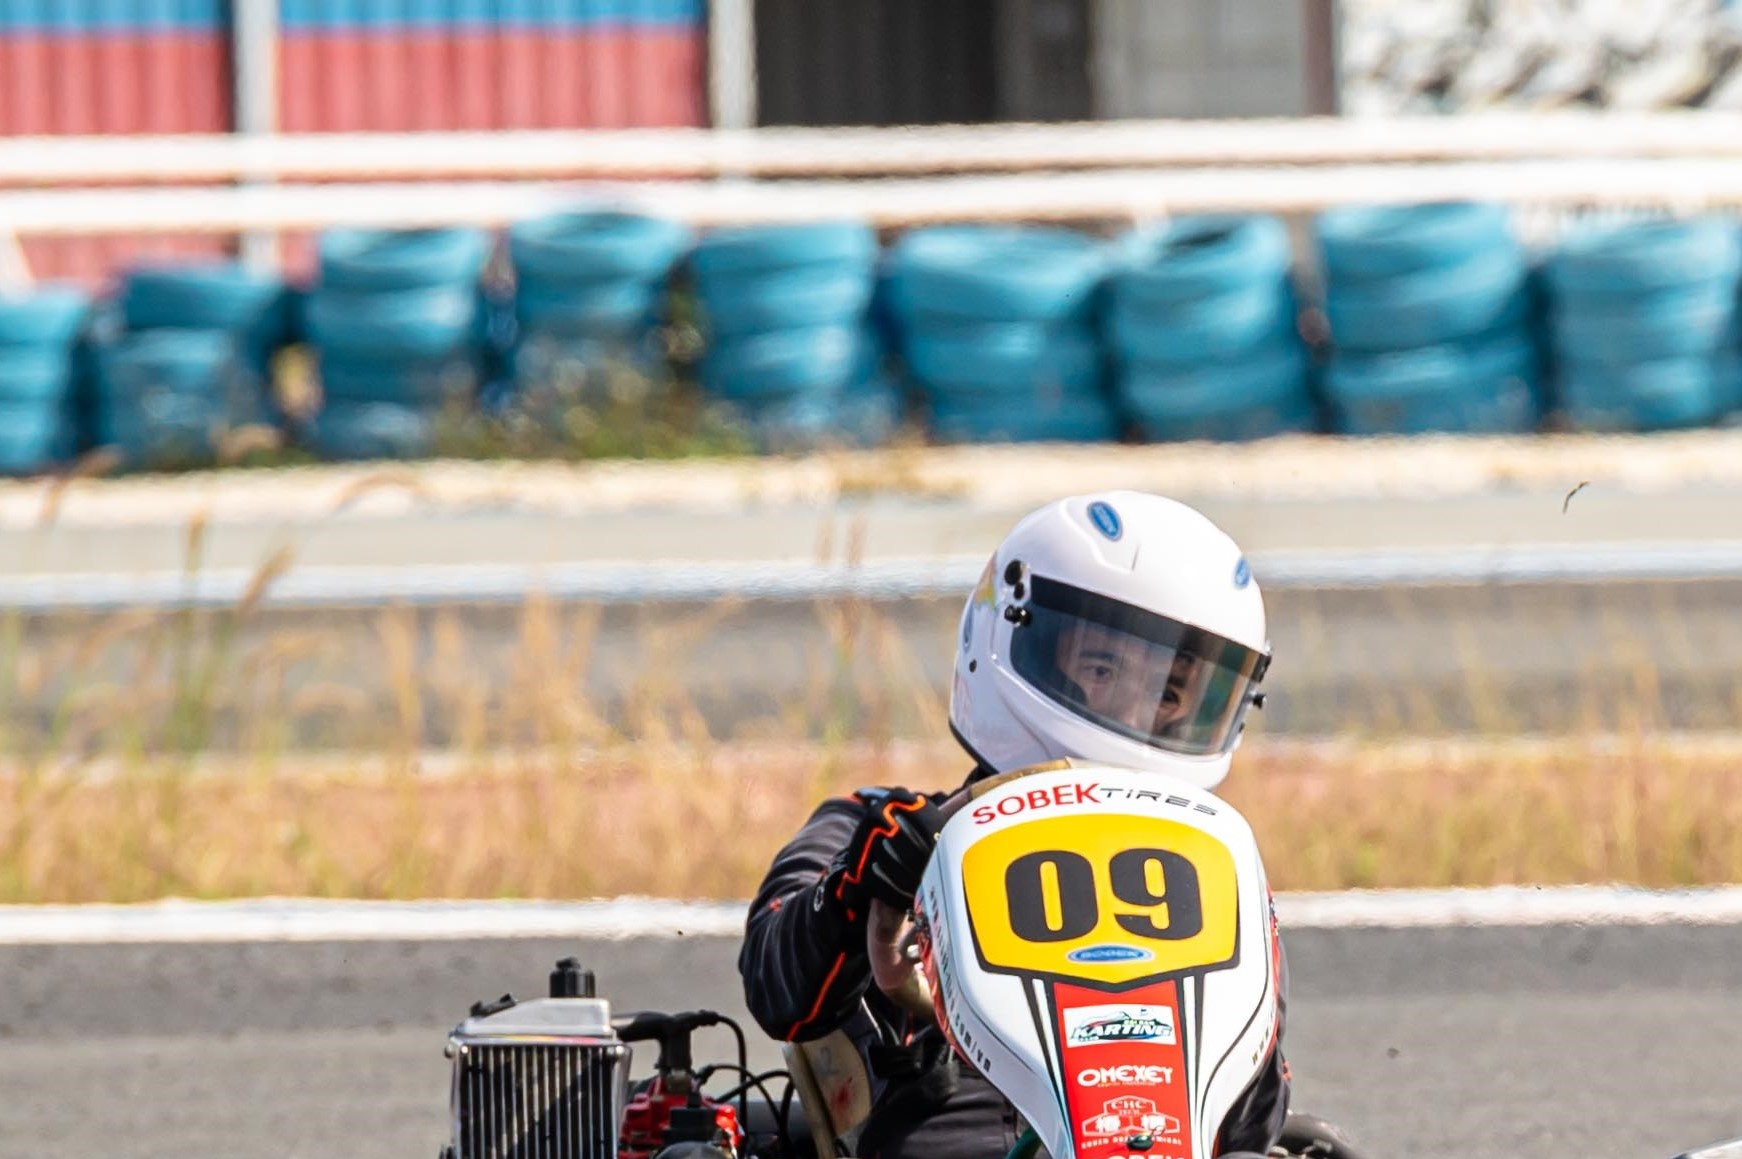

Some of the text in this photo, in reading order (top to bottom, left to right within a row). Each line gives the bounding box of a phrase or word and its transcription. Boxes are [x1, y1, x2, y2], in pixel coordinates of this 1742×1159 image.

[972, 783, 1100, 824] SOBEK
[1005, 848, 1203, 943] 09
[1070, 1023, 1172, 1040] KARTING
[1077, 1065, 1173, 1087] OMEXEY
